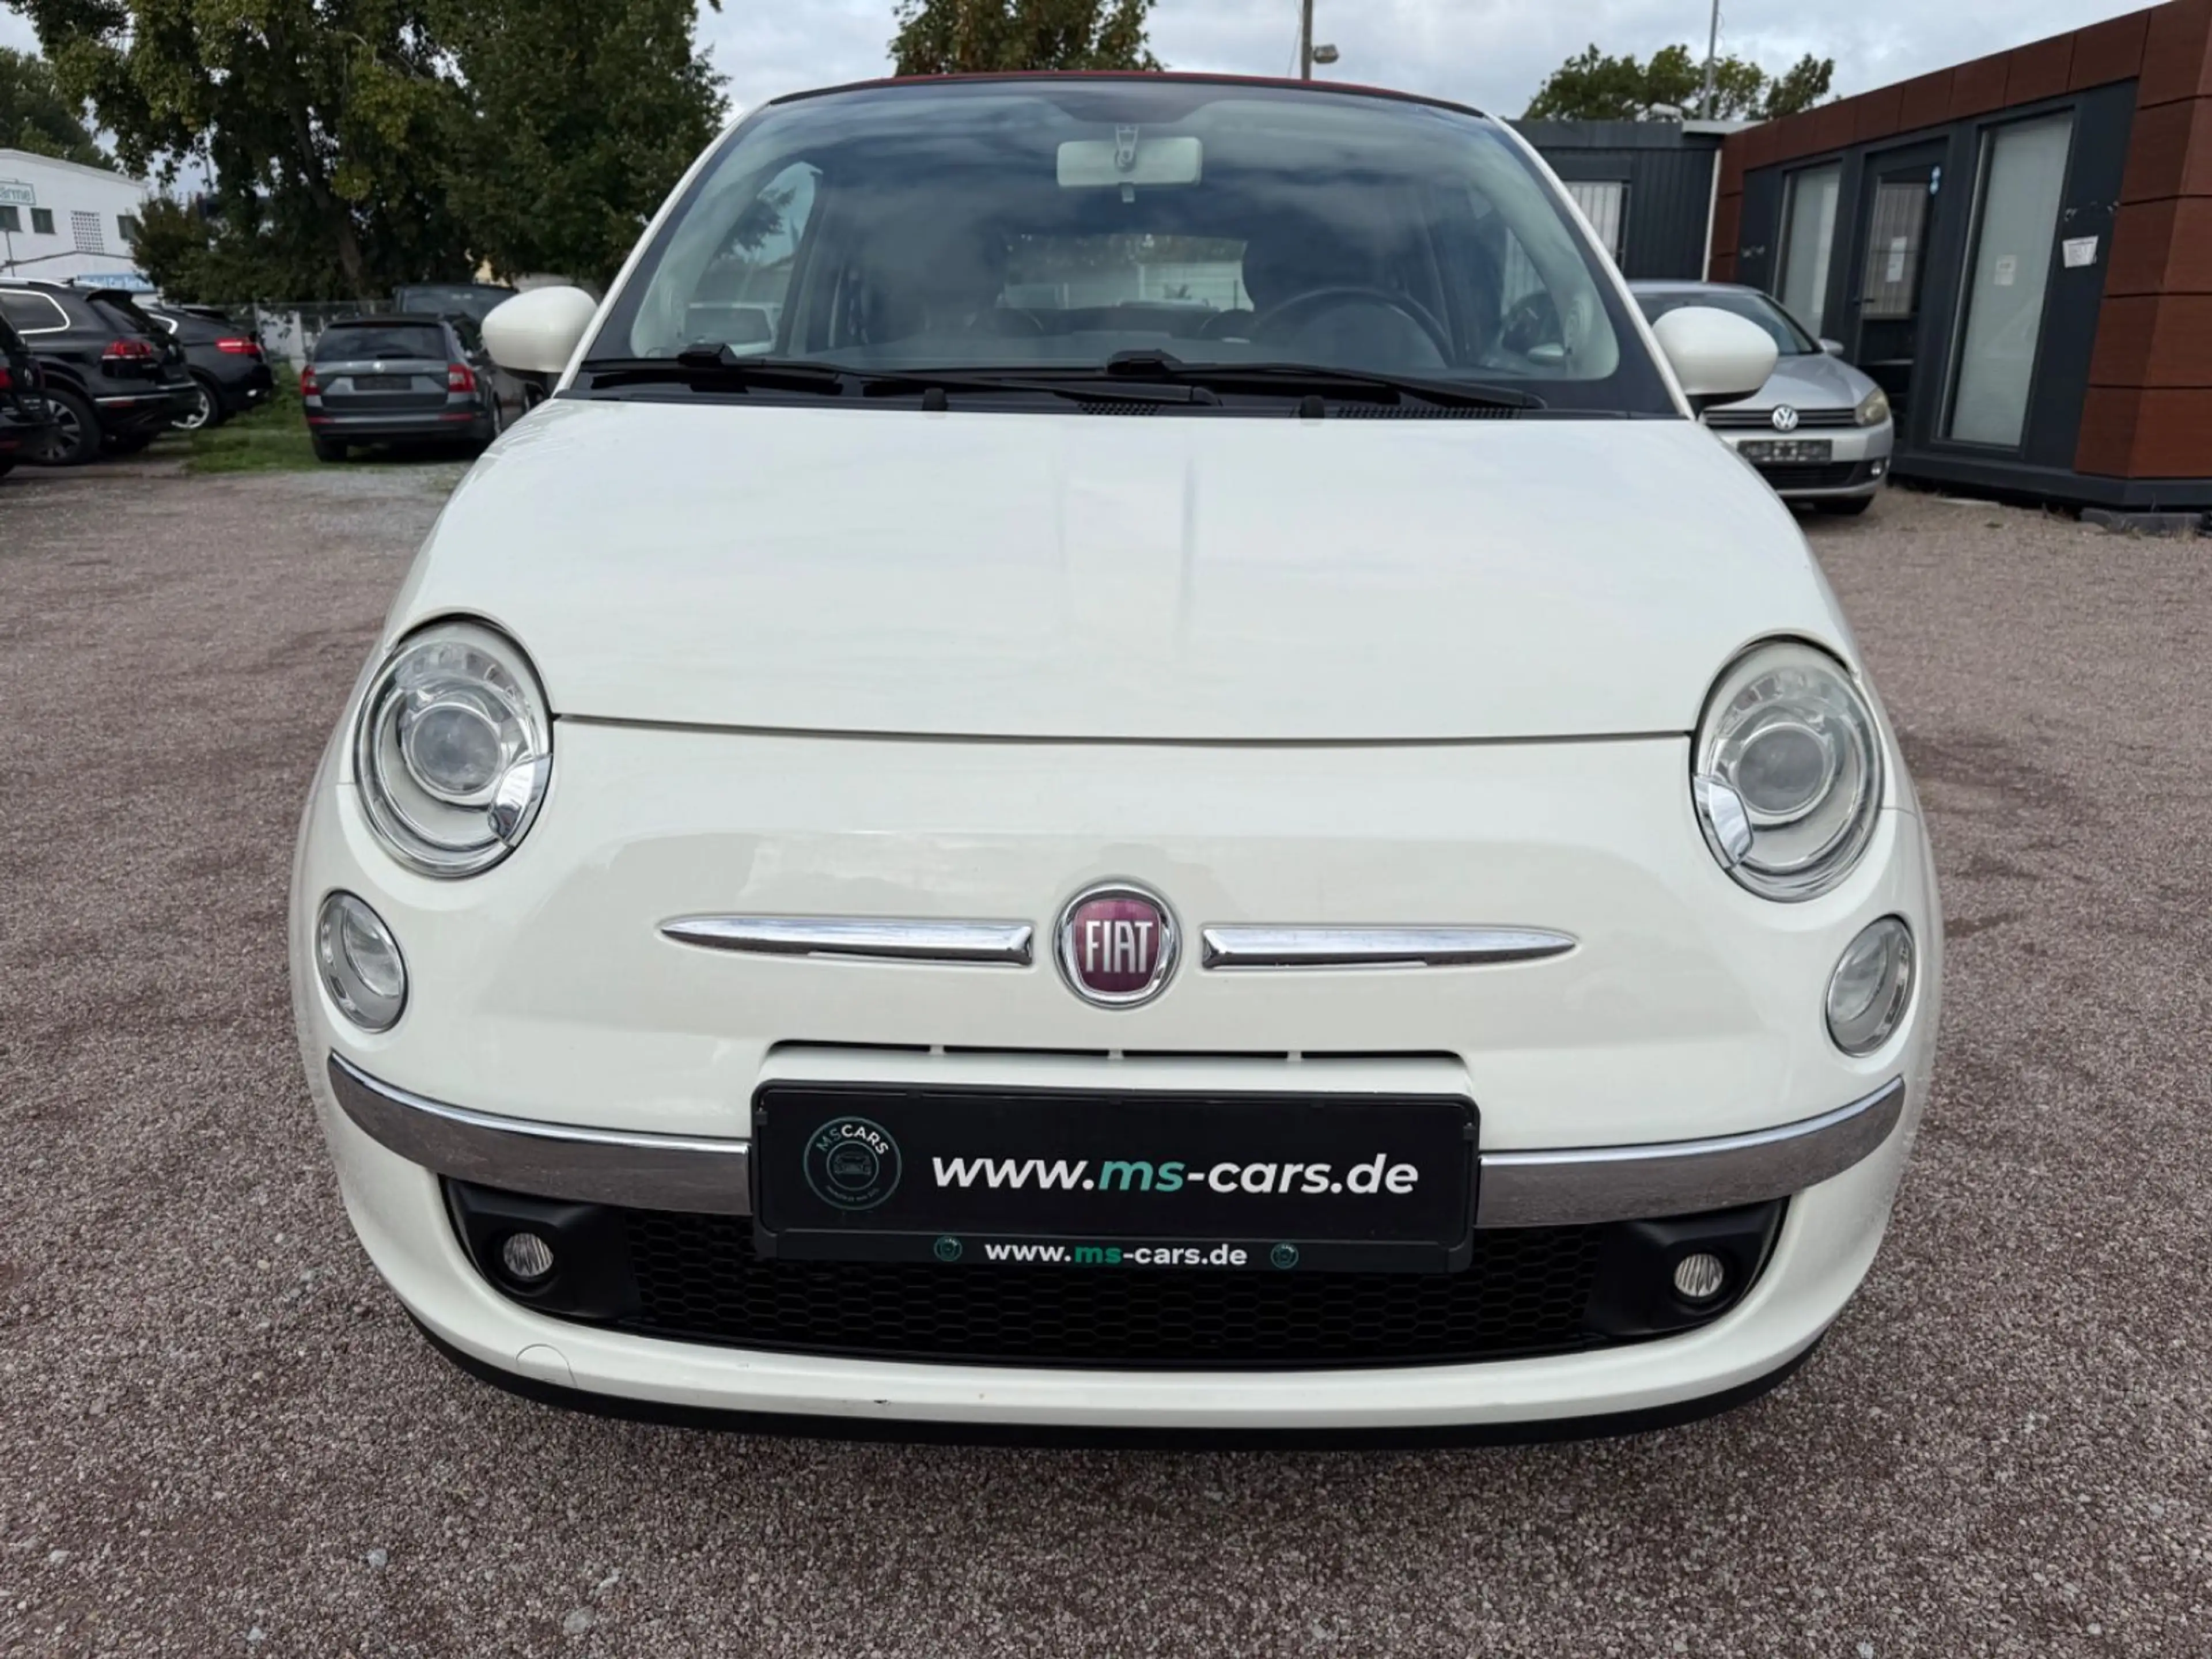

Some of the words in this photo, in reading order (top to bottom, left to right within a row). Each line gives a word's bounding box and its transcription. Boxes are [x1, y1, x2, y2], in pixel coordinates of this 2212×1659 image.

[1086, 920, 1153, 973] FIAT
[931, 1153, 1419, 1194] www.ms-cars.de
[984, 1243, 1248, 1266] www.ms-cars.de
